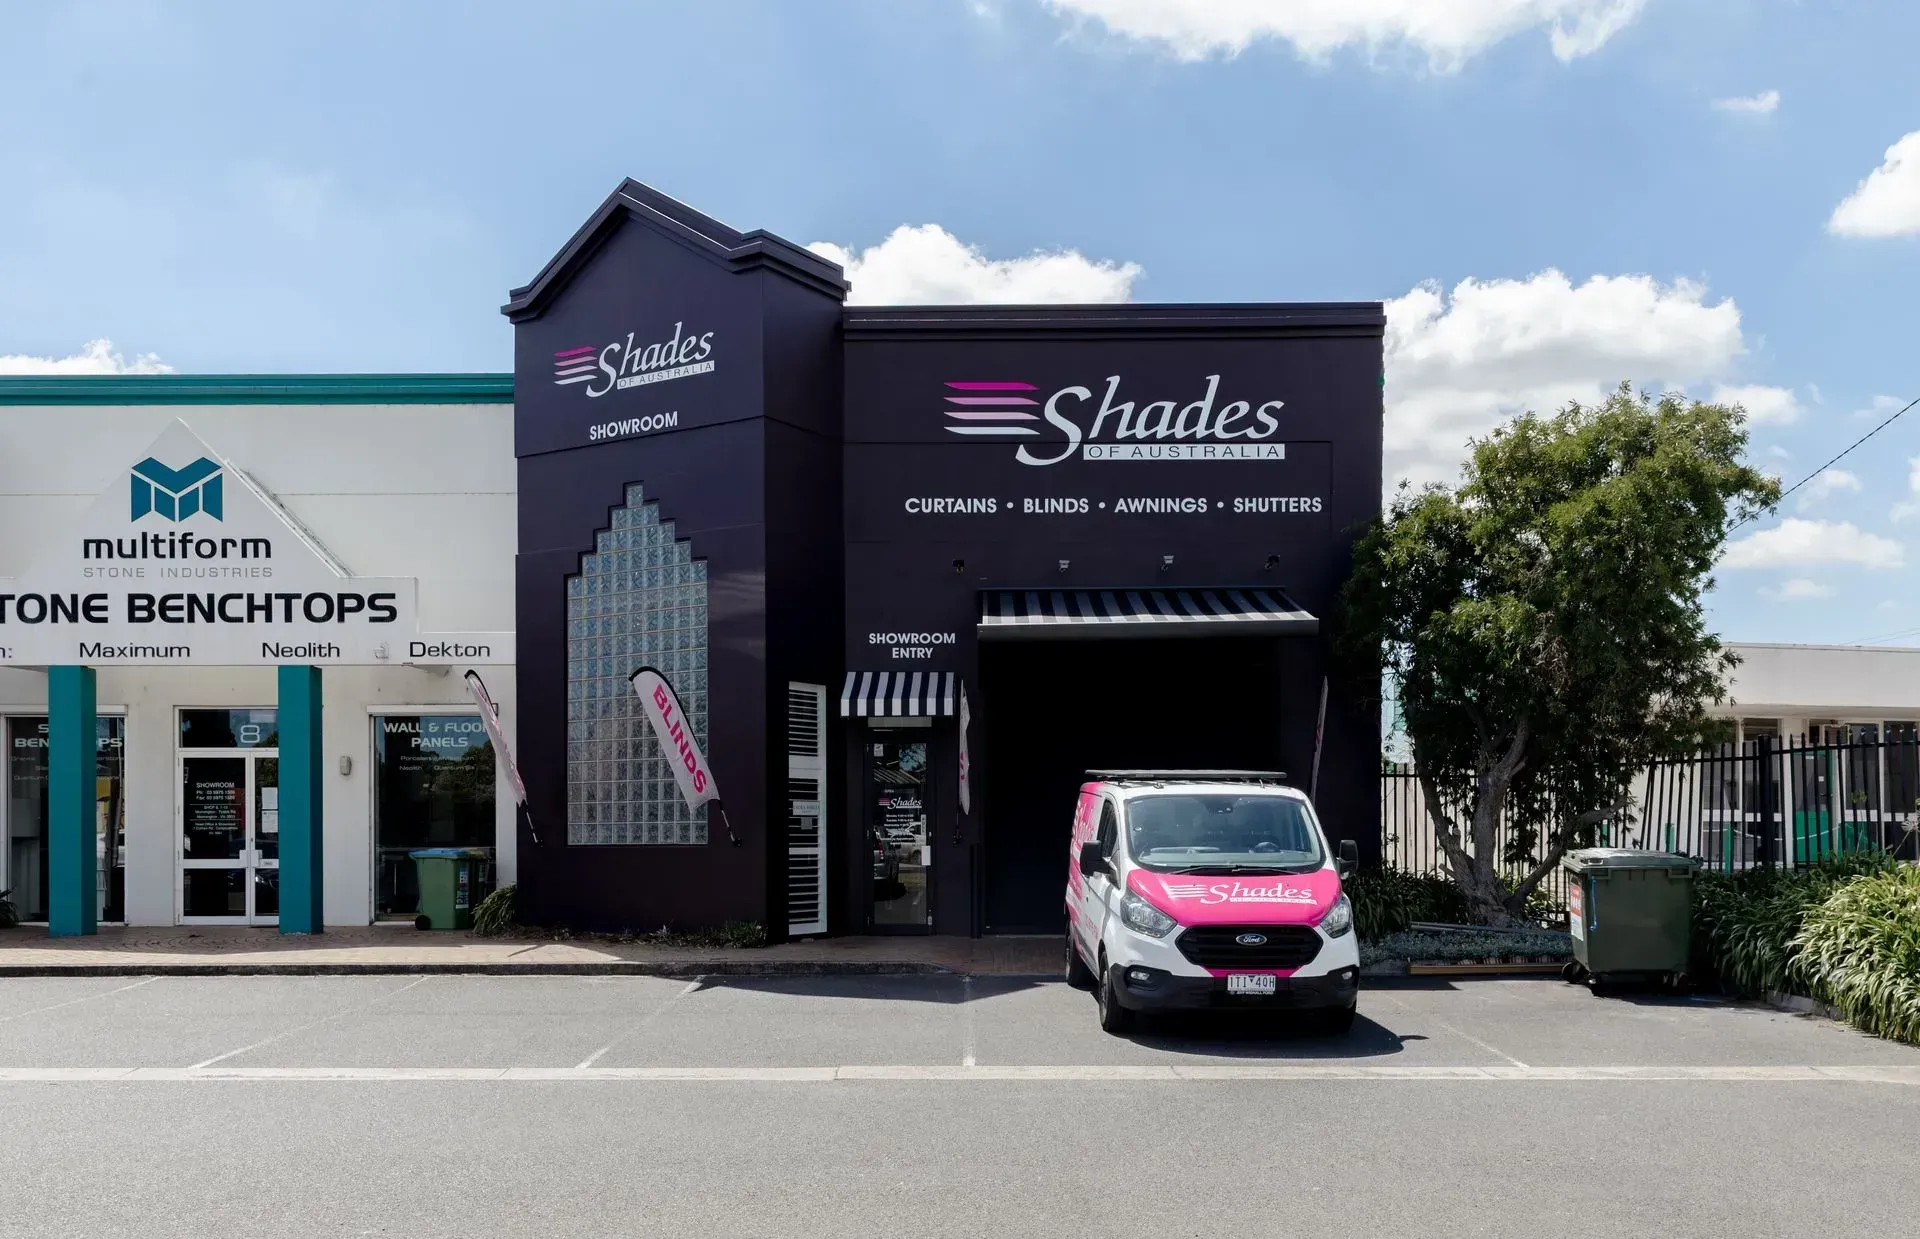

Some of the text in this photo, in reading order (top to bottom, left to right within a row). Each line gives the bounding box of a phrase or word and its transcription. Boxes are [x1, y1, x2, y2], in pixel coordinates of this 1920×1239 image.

[586, 321, 714, 397] Shades
[619, 362, 713, 388] OF AUSTRALIA
[590, 411, 678, 440] SHOWROOM
[1015, 374, 1286, 466] Shades
[1088, 445, 1281, 459] OF AUSTRALIA
[905, 498, 1322, 514] CURTAINS BLINDS AWNINGS SHUTTERS
[83, 531, 272, 559] multiform
[83, 567, 272, 578] STONE INDUSTRIES
[128, 592, 397, 624] BENCHTOPS
[869, 633, 956, 644] SHOWROOM
[79, 640, 491, 658] Maximum Neolith Dekton
[892, 648, 933, 659] ENTRY
[240, 725, 261, 743] 8
[383, 722, 488, 733] WALL & FLOO
[411, 737, 469, 748] PANELS
[653, 684, 707, 794] BLINDS
[887, 796, 922, 809] Shades
[1200, 881, 1313, 904] Shades
